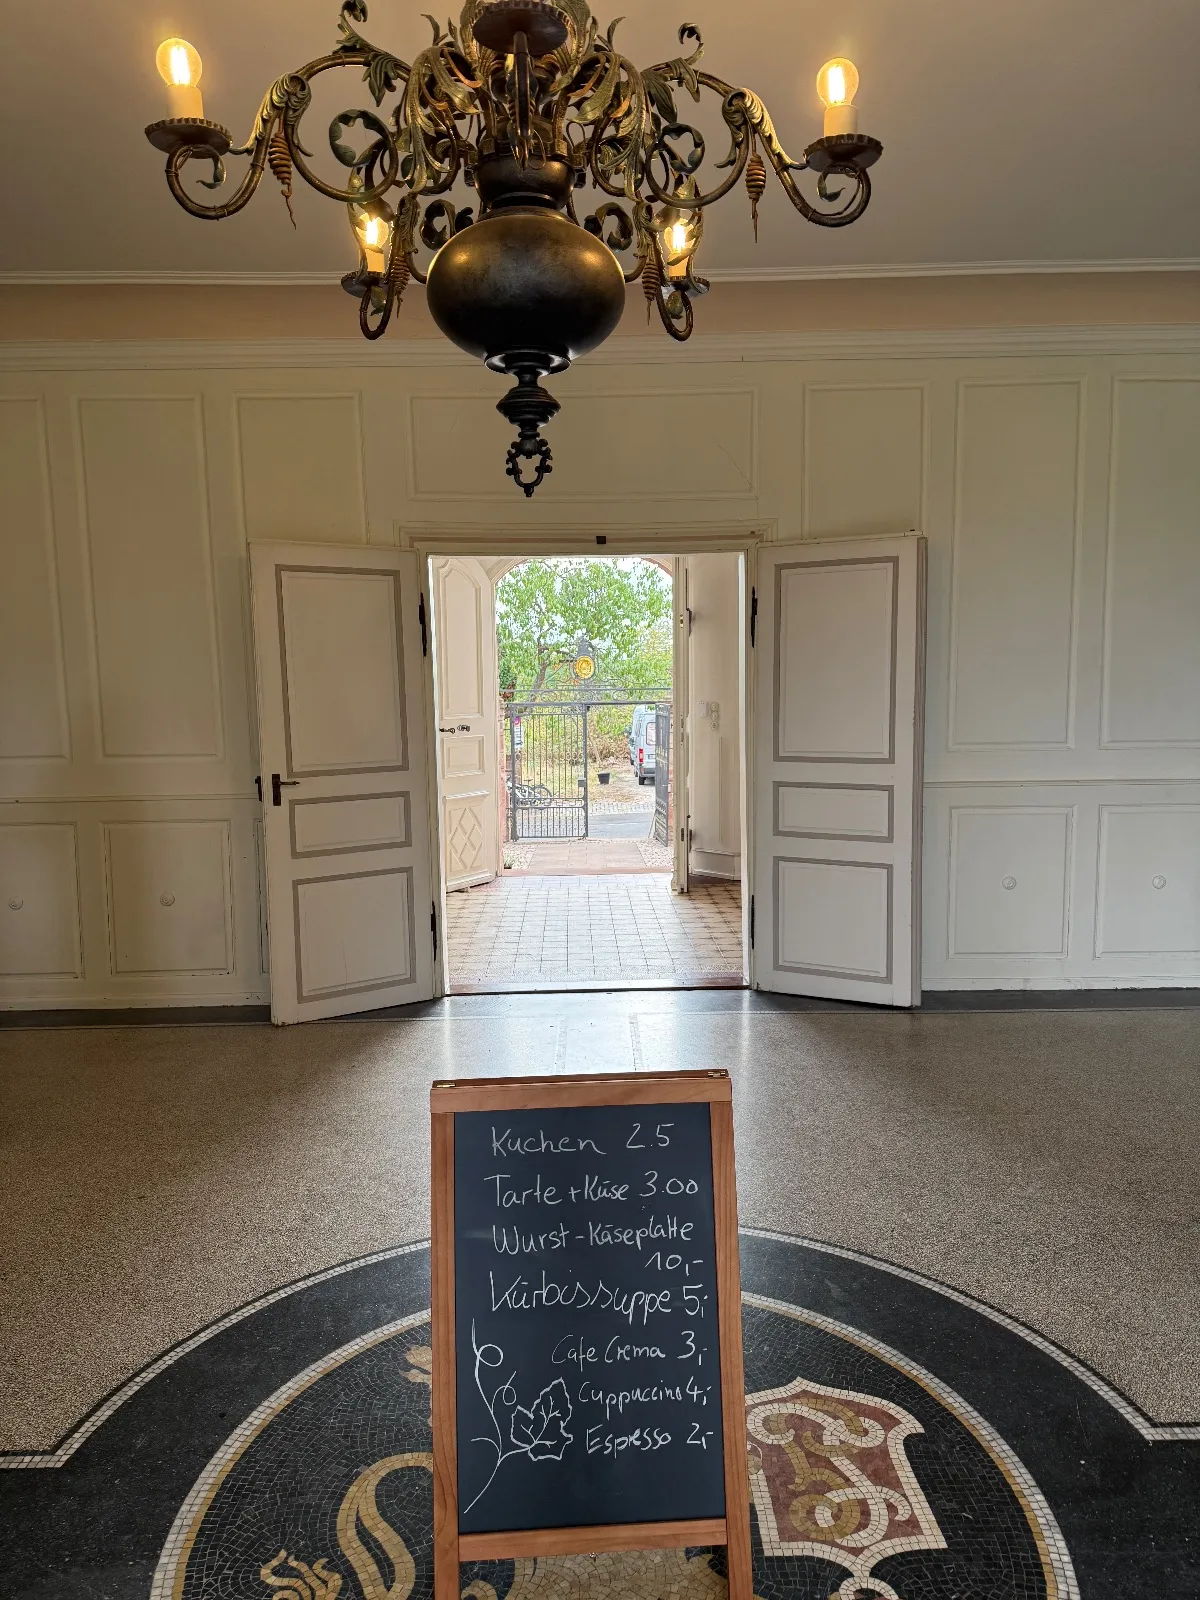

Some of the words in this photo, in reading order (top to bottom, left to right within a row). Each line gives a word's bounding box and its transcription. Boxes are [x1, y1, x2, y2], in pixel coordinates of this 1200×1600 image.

[491, 1126, 606, 1156] Kuchen
[625, 1123, 675, 1148] 2.5
[483, 1174, 563, 1207] Tarte
[639, 1170, 699, 1197] 3.00
[489, 1270, 672, 1325] Kürbissuppe
[551, 1334, 599, 1371] Cafe
[586, 1424, 672, 1458] Espresso
